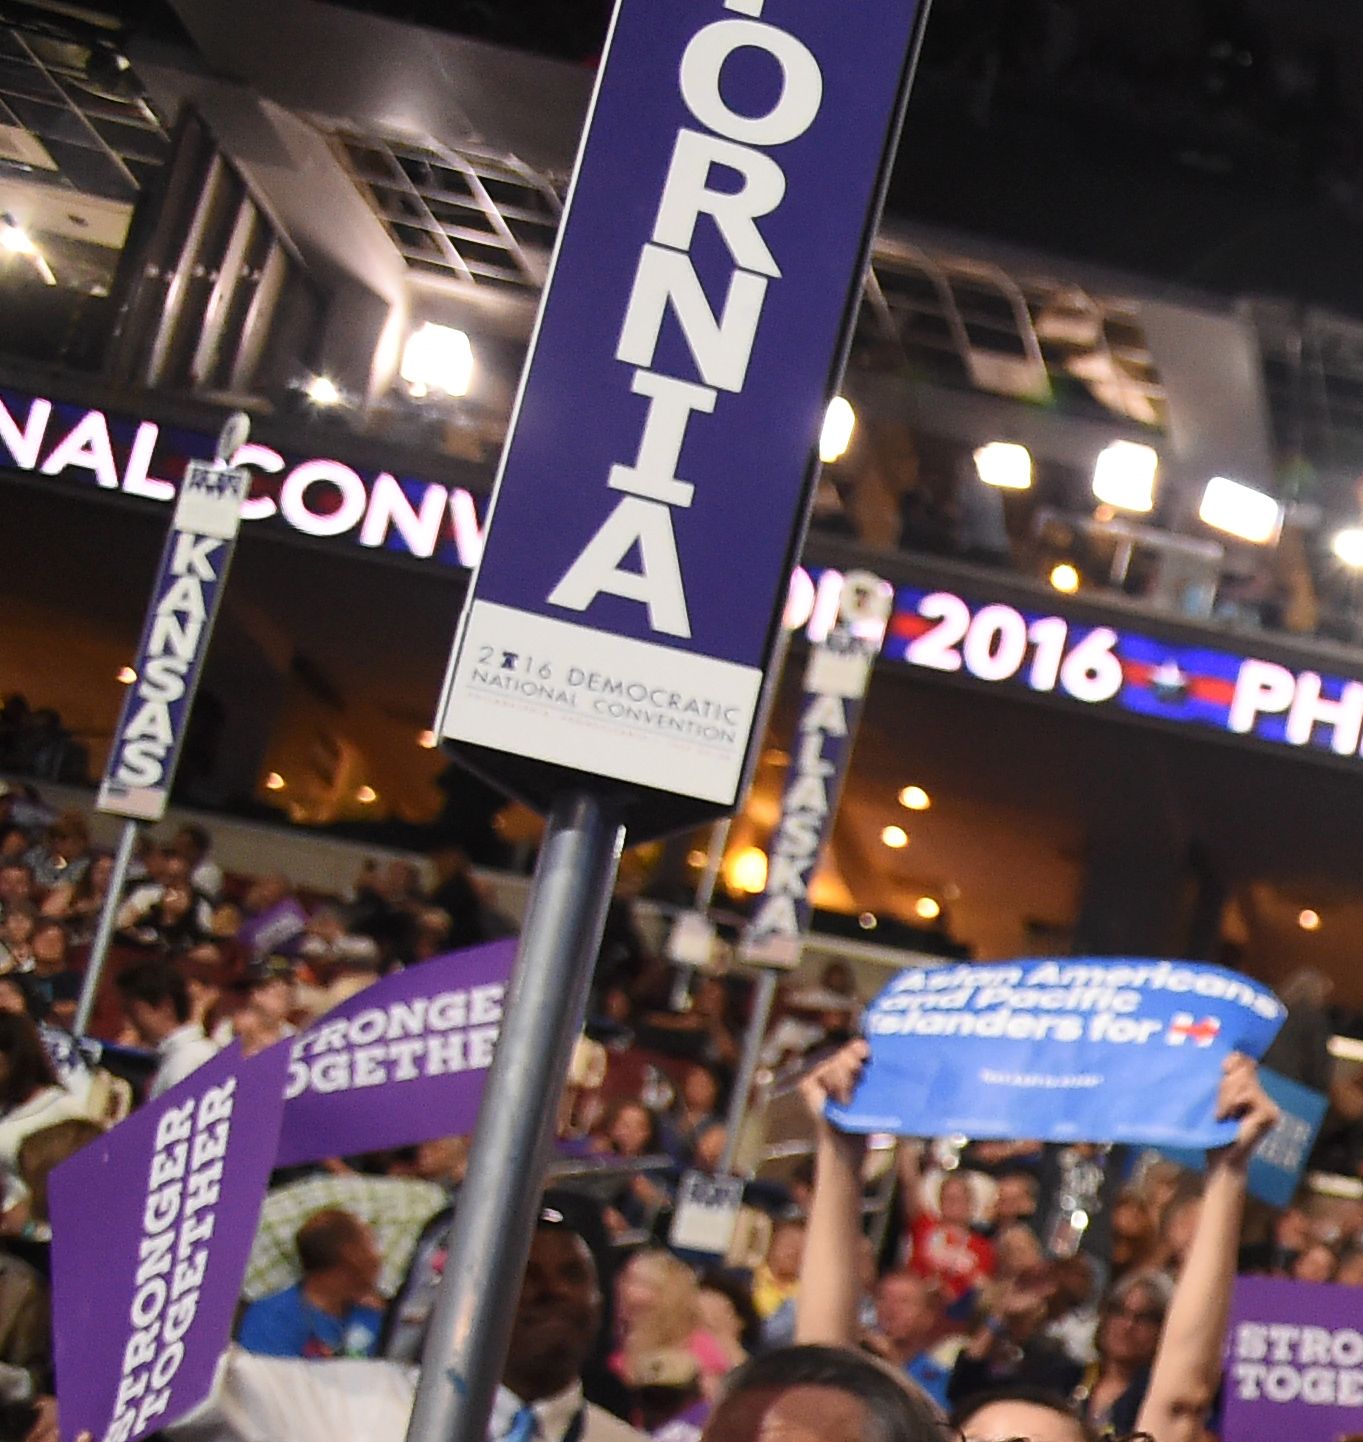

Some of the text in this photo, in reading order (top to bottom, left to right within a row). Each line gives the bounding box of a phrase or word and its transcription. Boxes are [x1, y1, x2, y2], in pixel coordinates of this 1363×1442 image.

[547, 0, 824, 639] ORNIA
[115, 530, 224, 788] KANSAS
[905, 591, 1123, 703] 2016
[470, 667, 577, 708] NATIONAL
[591, 698, 737, 744] CONVENTION
[566, 666, 743, 727] DEMOCRATIC
[752, 694, 848, 940] ALASKA
[290, 982, 506, 1060] TRONGE
[868, 1007, 1085, 1043] slanders
[1087, 1009, 1164, 1045] for
[975, 984, 1142, 1015] Pacific
[1026, 960, 1288, 1021] Americans
[283, 1026, 501, 1100] OGETHE
[133, 1076, 237, 1436] TOGETHER
